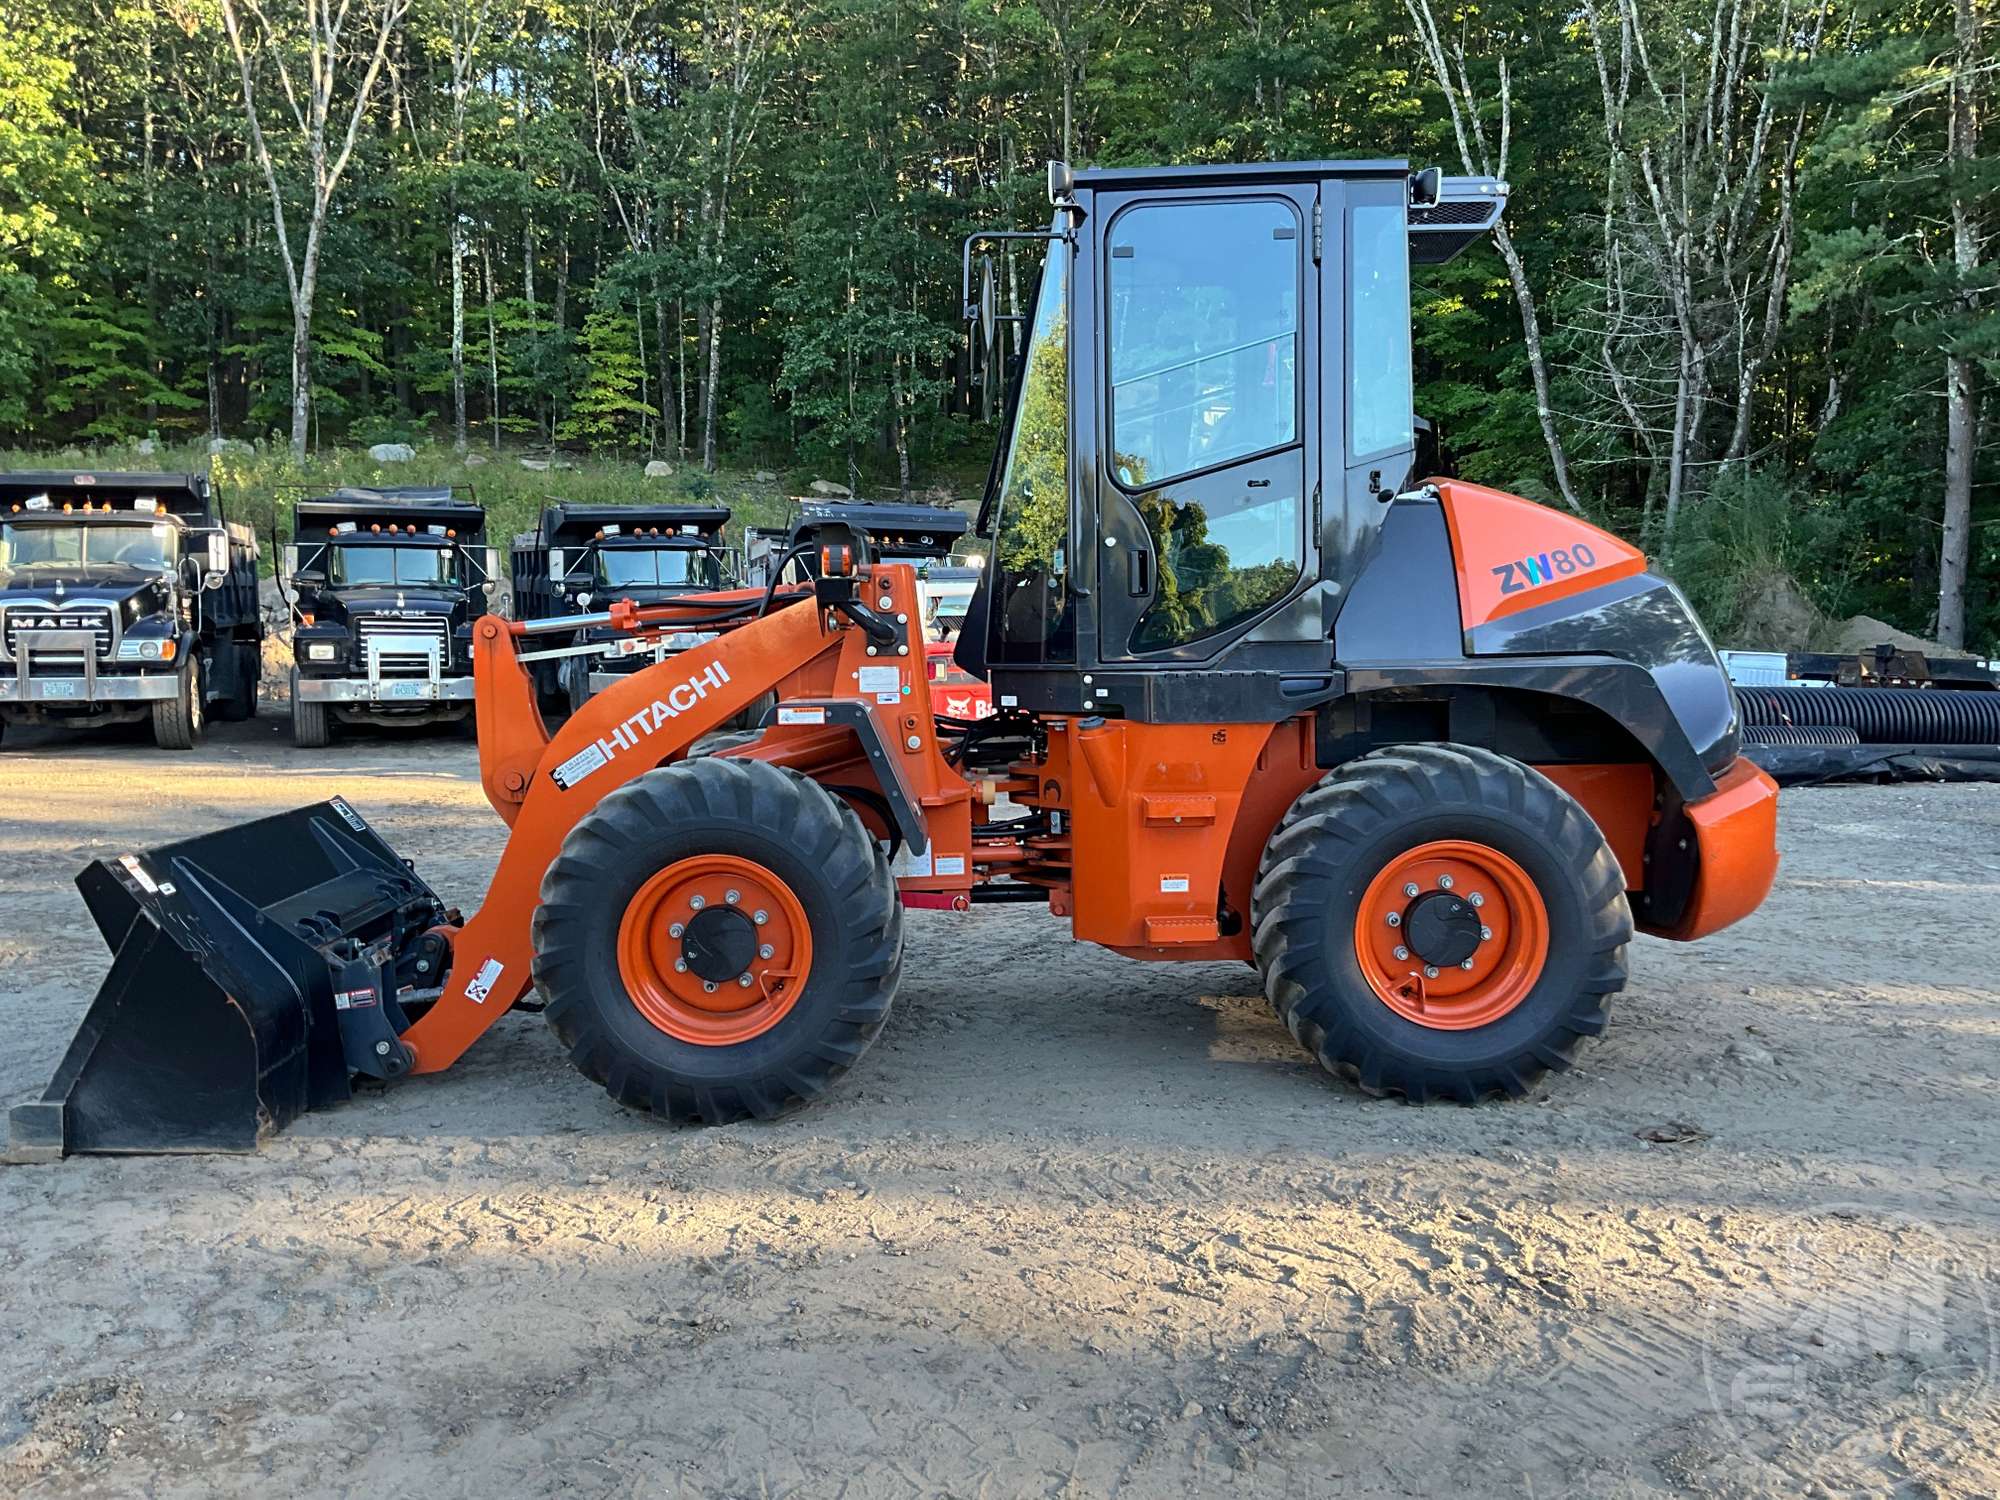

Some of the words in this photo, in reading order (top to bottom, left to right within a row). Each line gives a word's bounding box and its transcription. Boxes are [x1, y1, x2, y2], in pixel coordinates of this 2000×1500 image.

[1491, 543, 1596, 595] ZW80
[11, 618, 103, 628] MACK
[596, 660, 731, 760] HITACHI
